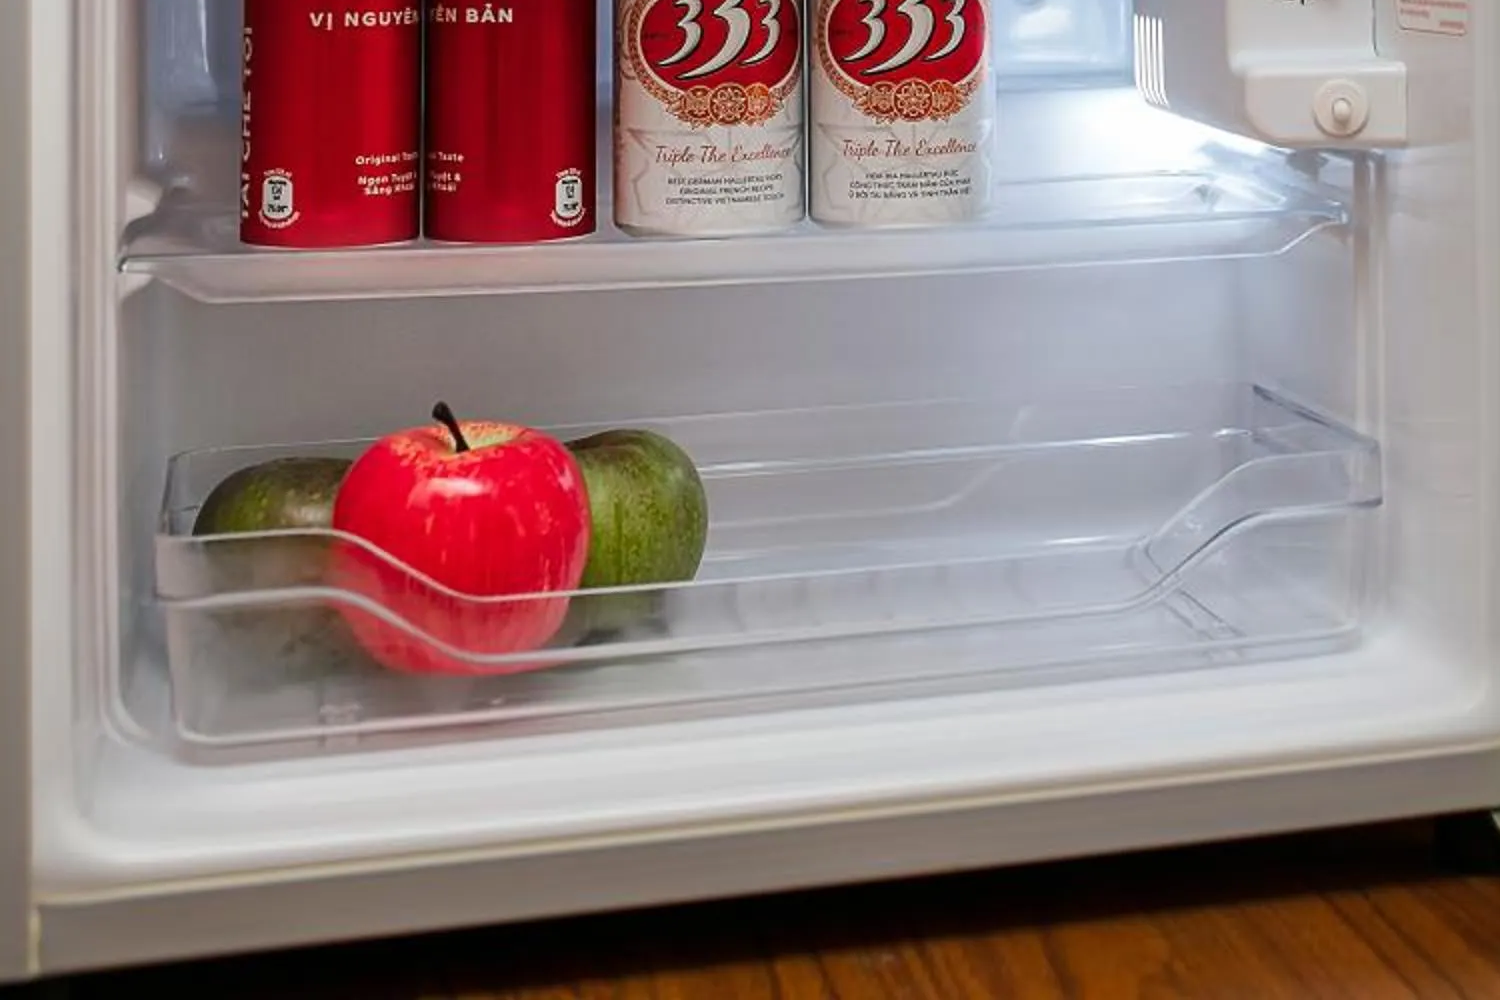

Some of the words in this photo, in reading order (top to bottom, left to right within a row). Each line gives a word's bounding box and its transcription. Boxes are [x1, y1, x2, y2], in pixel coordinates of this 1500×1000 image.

[355, 152, 400, 167] Original
[656, 145, 695, 167] Triple
[700, 144, 727, 163] The
[842, 138, 879, 161] Triple
[885, 138, 911, 157] The
